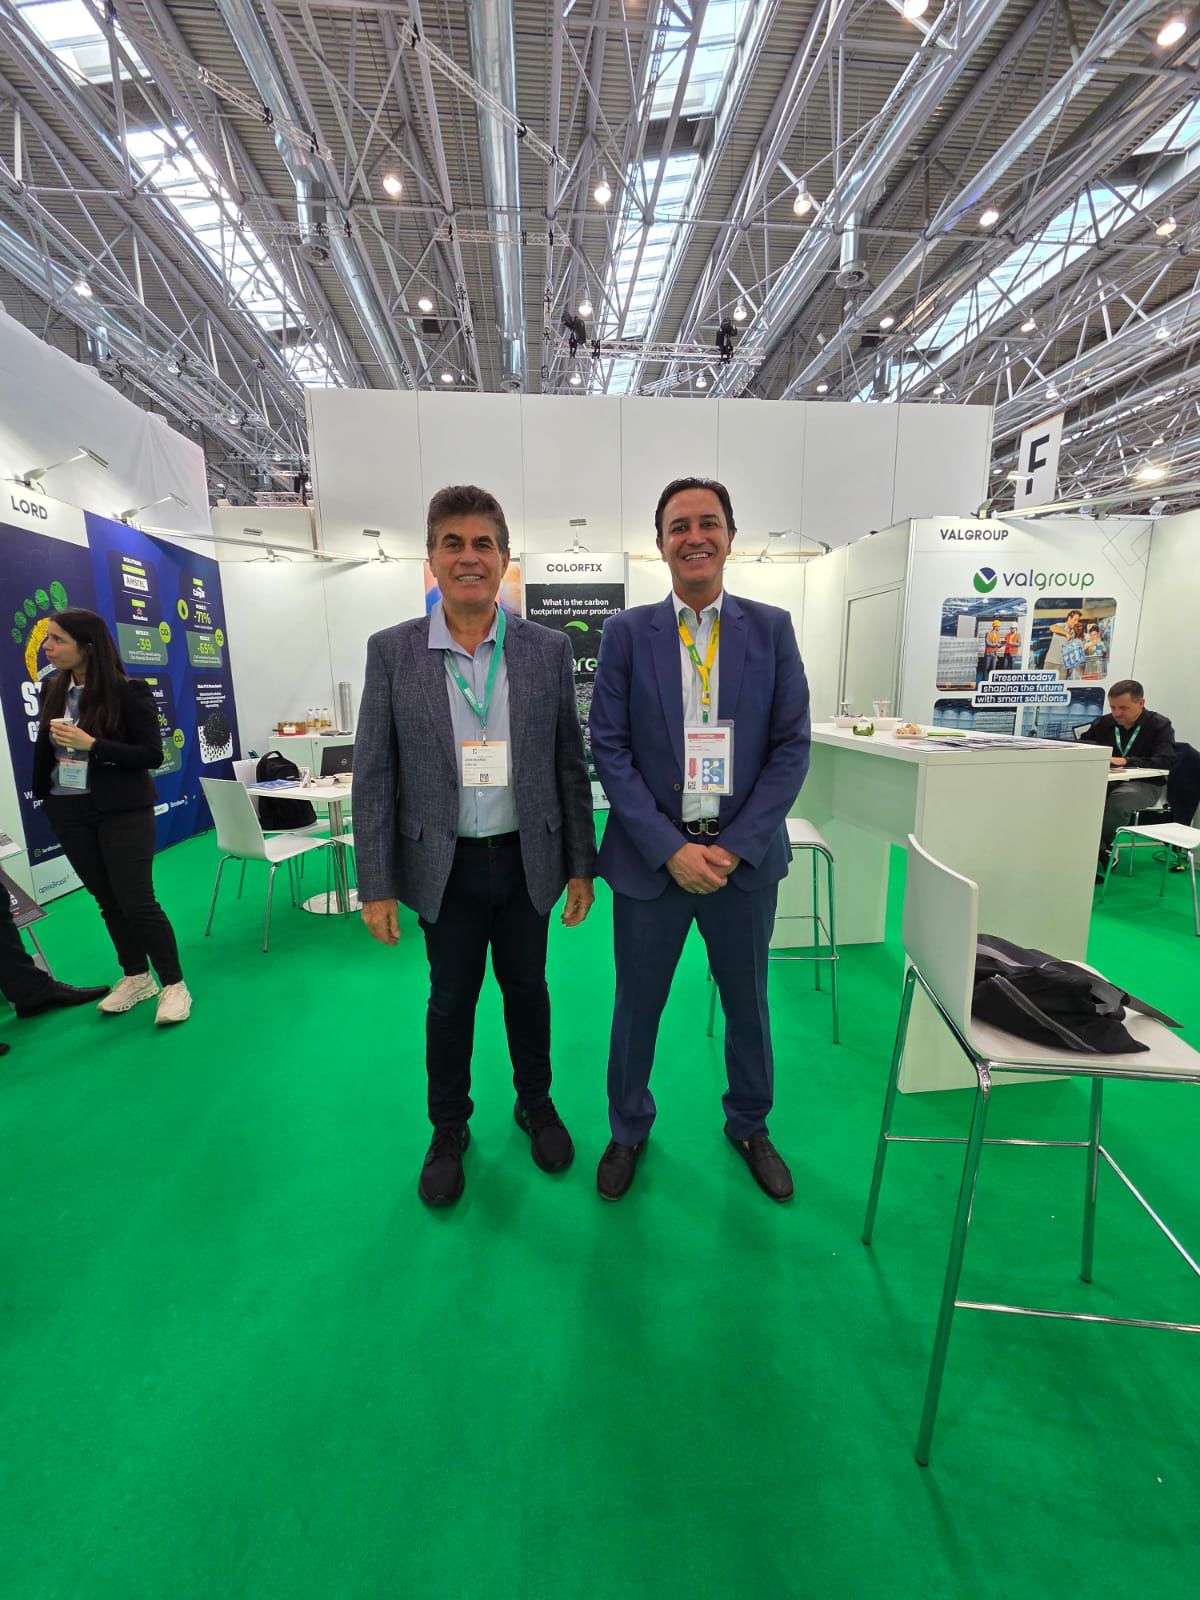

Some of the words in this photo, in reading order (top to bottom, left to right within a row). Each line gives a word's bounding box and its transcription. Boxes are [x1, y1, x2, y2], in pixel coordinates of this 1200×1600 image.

[1025, 433, 1050, 496] F
[11, 495, 48, 520] LORD
[940, 529, 1009, 541] VALGROUP
[546, 563, 603, 573] COLORFIX
[1002, 569, 1095, 591] valgroup
[530, 608, 562, 616] footprint
[589, 608, 621, 616] product?
[993, 673, 1026, 682] Present
[983, 684, 1018, 693] shaping
[1020, 684, 1034, 692] the
[976, 695, 995, 703] with
[1024, 693, 1067, 702] solutions.
